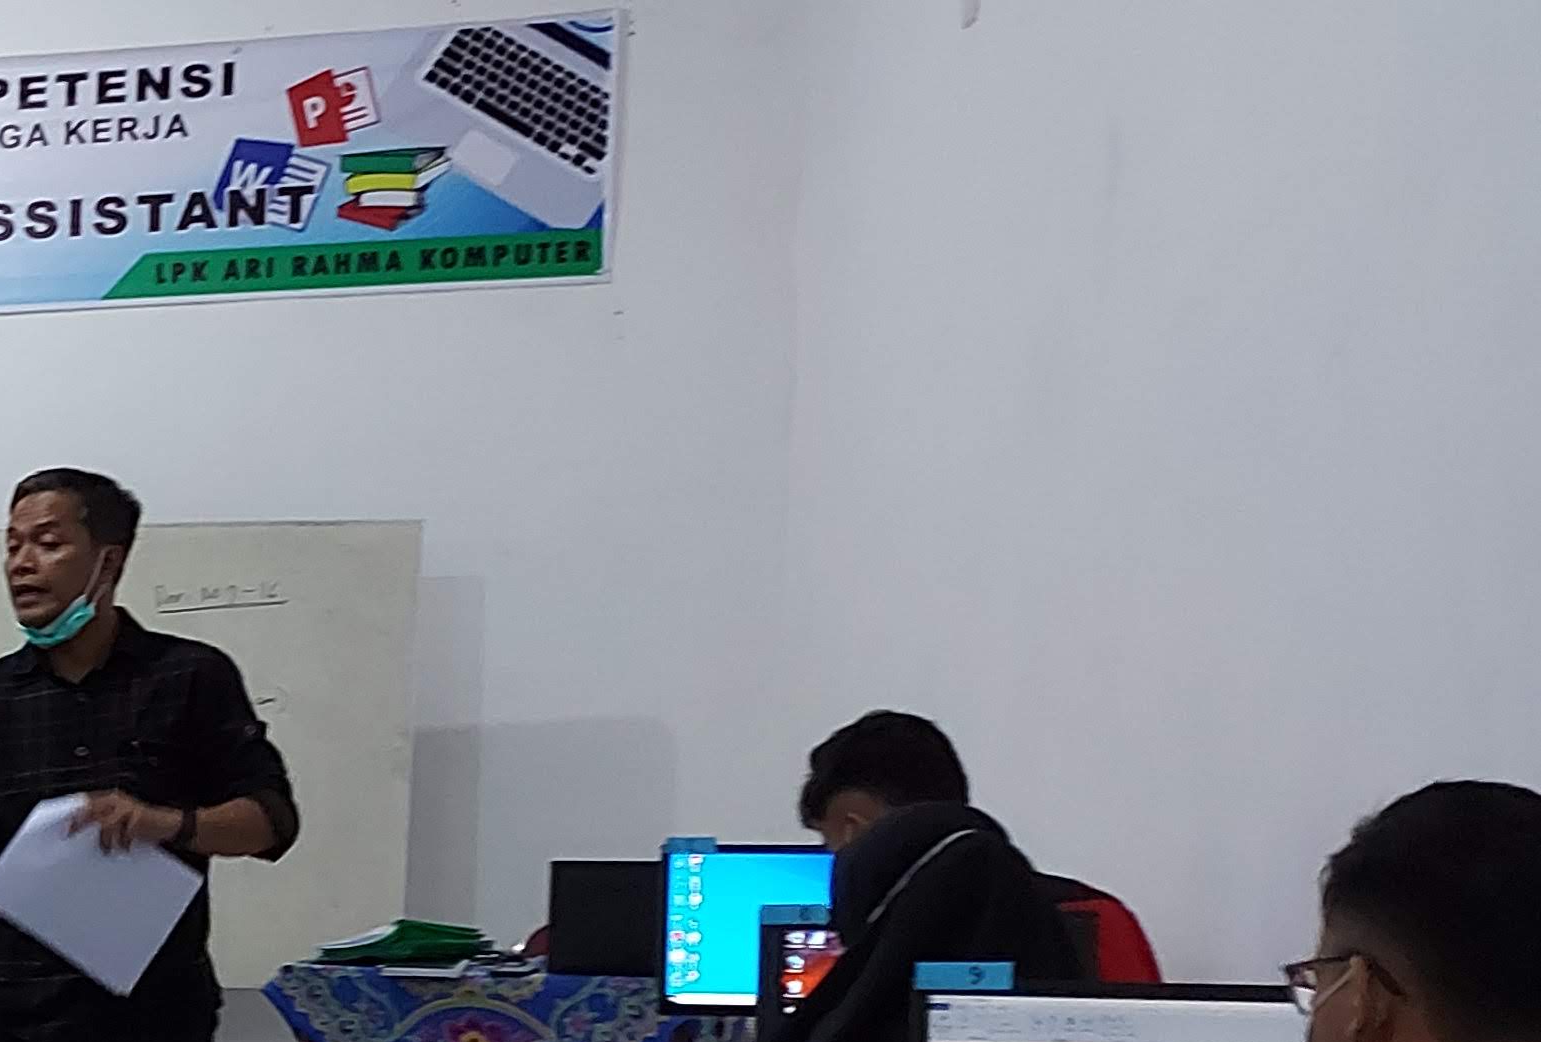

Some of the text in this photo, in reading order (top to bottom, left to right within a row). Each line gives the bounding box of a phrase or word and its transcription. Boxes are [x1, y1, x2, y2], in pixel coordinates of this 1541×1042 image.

[302, 96, 326, 129] P
[64, 114, 189, 145] KERJA
[155, 239, 592, 285] LPK ARI RAHMA KOMPUTER
